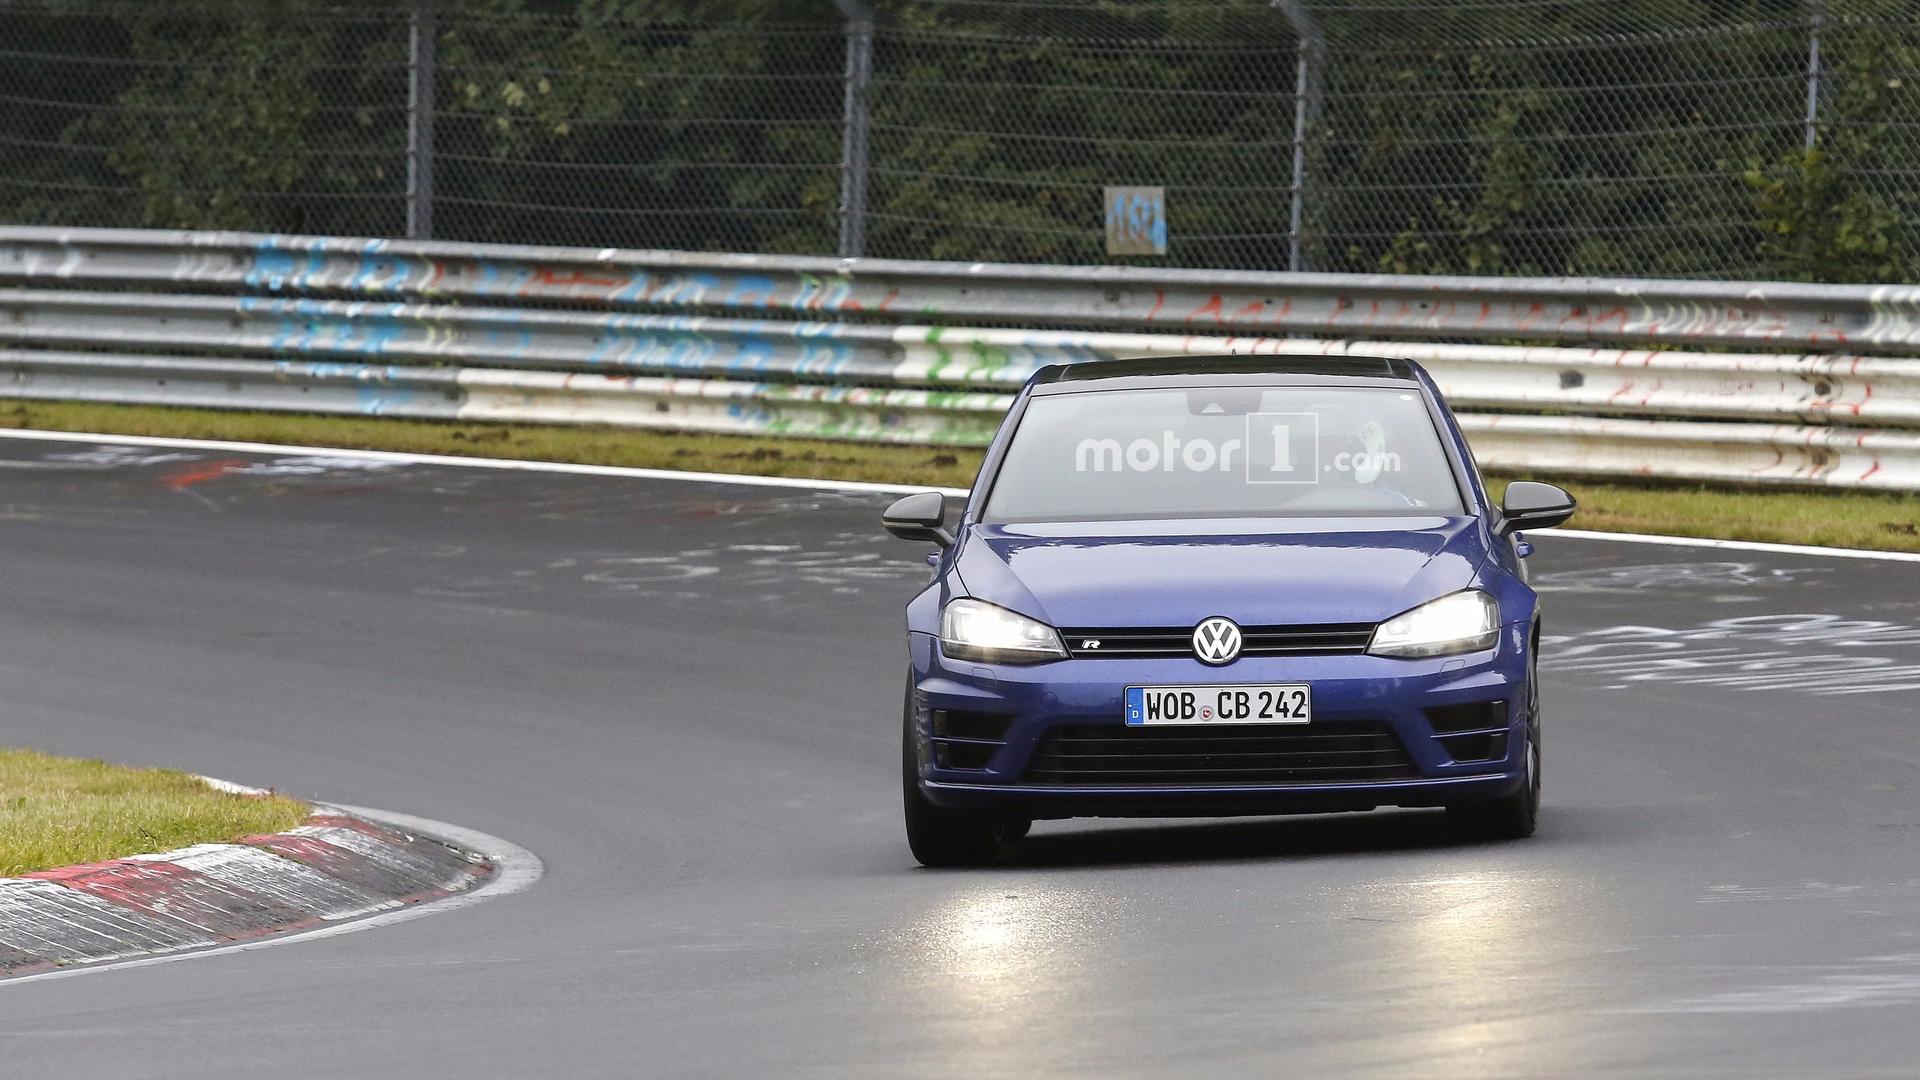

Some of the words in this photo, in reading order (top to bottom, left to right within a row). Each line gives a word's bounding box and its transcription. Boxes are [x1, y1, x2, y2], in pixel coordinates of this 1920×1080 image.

[1081, 639, 1101, 649] R
[1146, 692, 1196, 720] WOB
[1217, 691, 1250, 719] CB
[1258, 690, 1307, 718] 242
[1132, 709, 1139, 719] D
